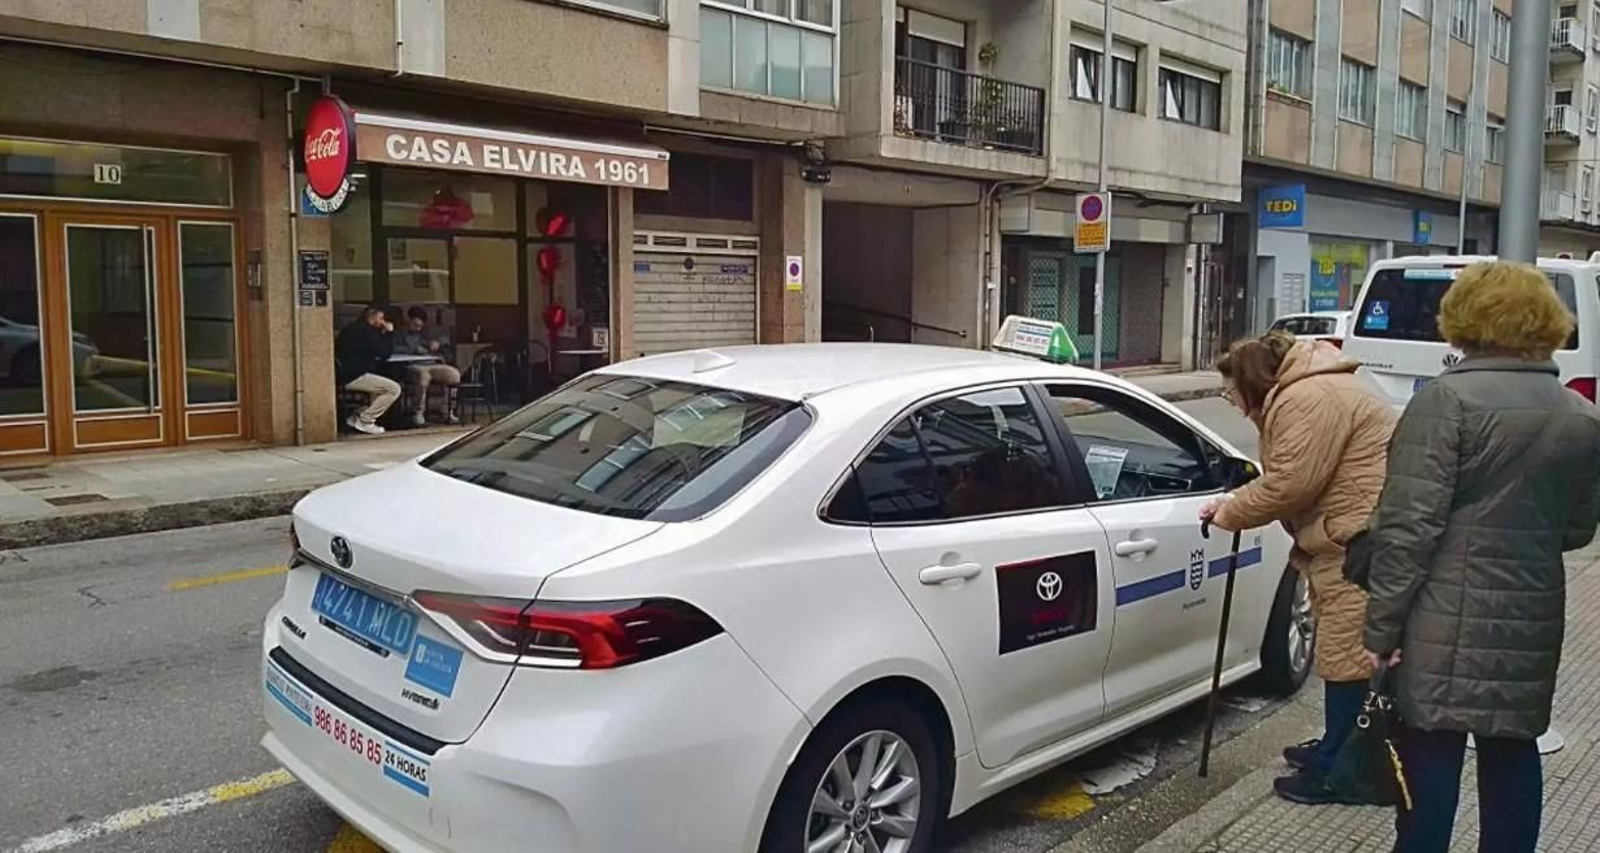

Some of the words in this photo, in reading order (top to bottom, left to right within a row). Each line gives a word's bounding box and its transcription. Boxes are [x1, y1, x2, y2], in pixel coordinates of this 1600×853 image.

[98, 165, 119, 182] 10
[385, 134, 474, 168] CASA
[483, 145, 586, 179] ELVIRA
[594, 158, 650, 185] 1961
[369, 601, 413, 648] MLD
[314, 705, 332, 735] 986
[333, 719, 347, 745] 86
[350, 729, 363, 754] 85
[367, 739, 382, 765] 85
[385, 750, 396, 765] 24
[397, 758, 426, 782] HORAS
